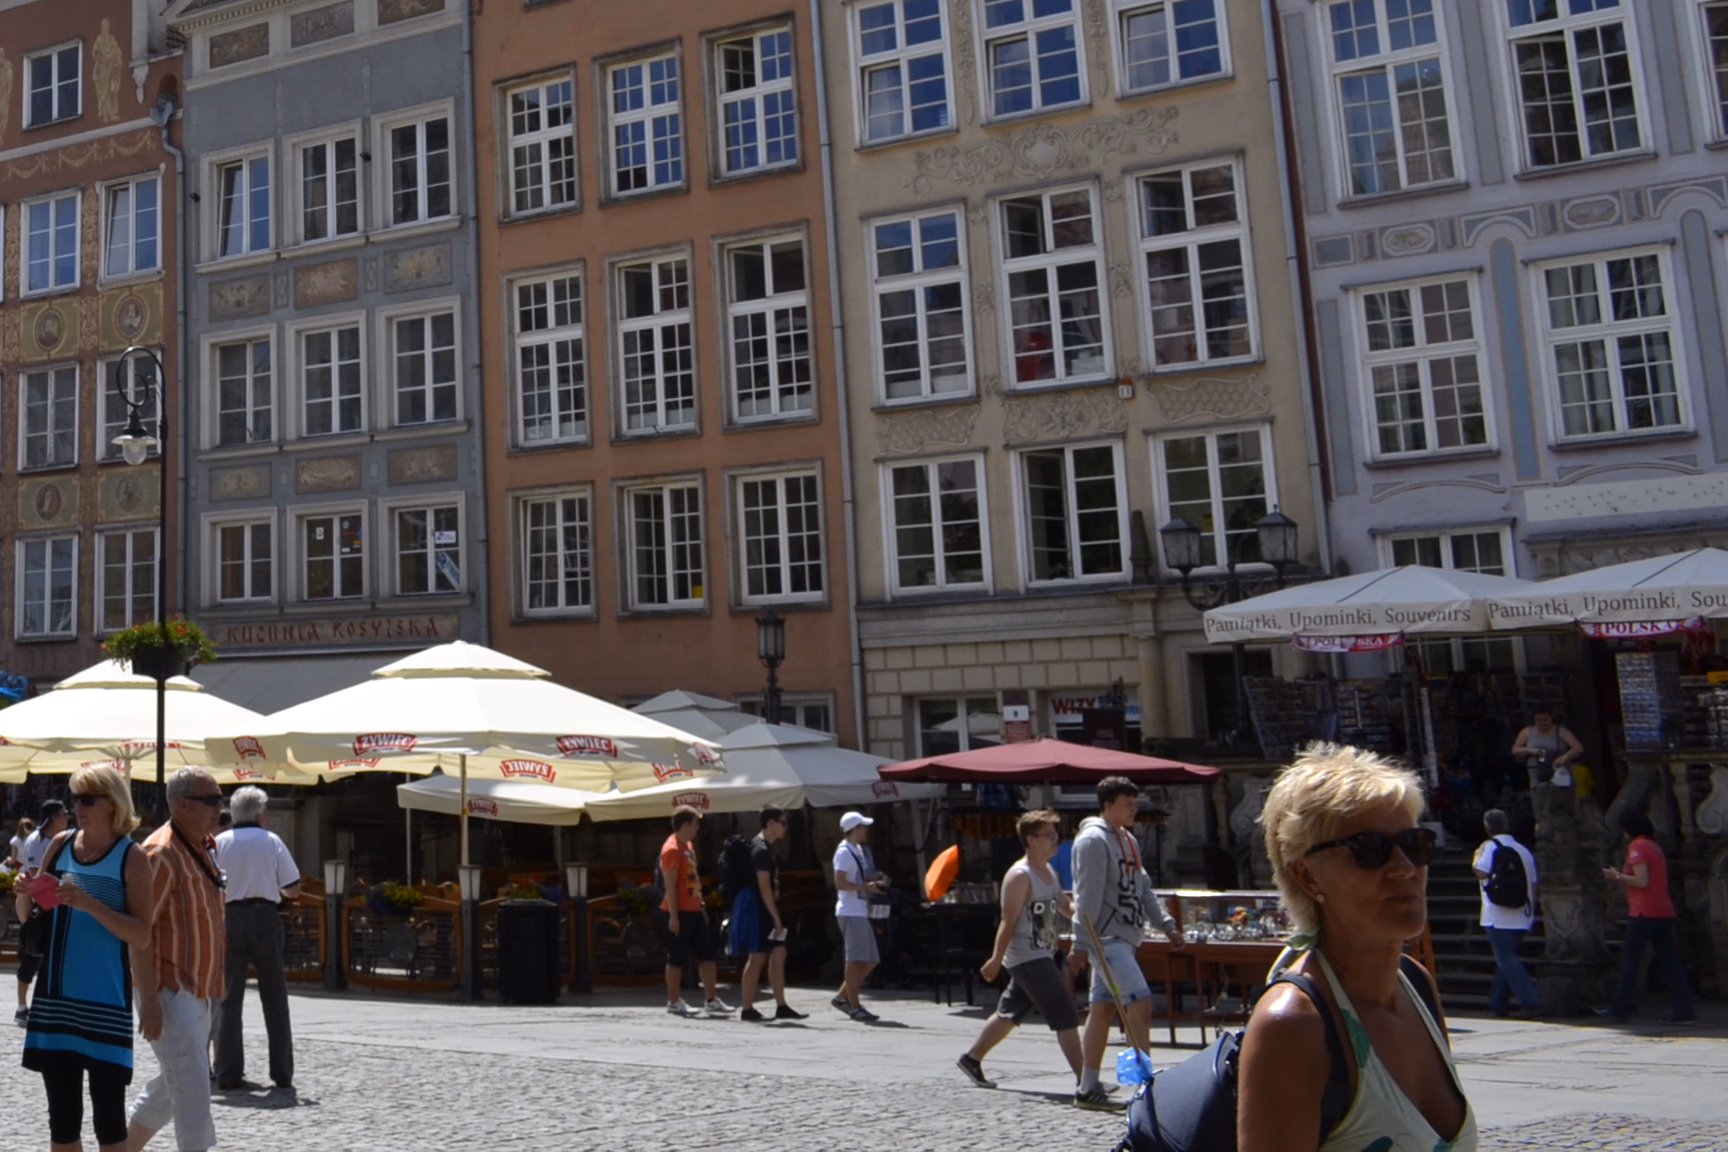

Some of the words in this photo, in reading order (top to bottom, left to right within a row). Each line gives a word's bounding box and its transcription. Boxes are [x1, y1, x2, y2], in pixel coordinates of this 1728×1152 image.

[1488, 599, 1574, 620] Pamiątki,
[1583, 592, 1680, 616] Upominki,
[1691, 591, 1728, 608] Sou
[227, 622, 320, 644] KUCHNIA
[332, 616, 439, 639] ROSYJSKA
[1206, 614, 1282, 634] Pamiątki,
[1289, 608, 1377, 631] Upominki,
[1384, 606, 1471, 625] Souvenirs
